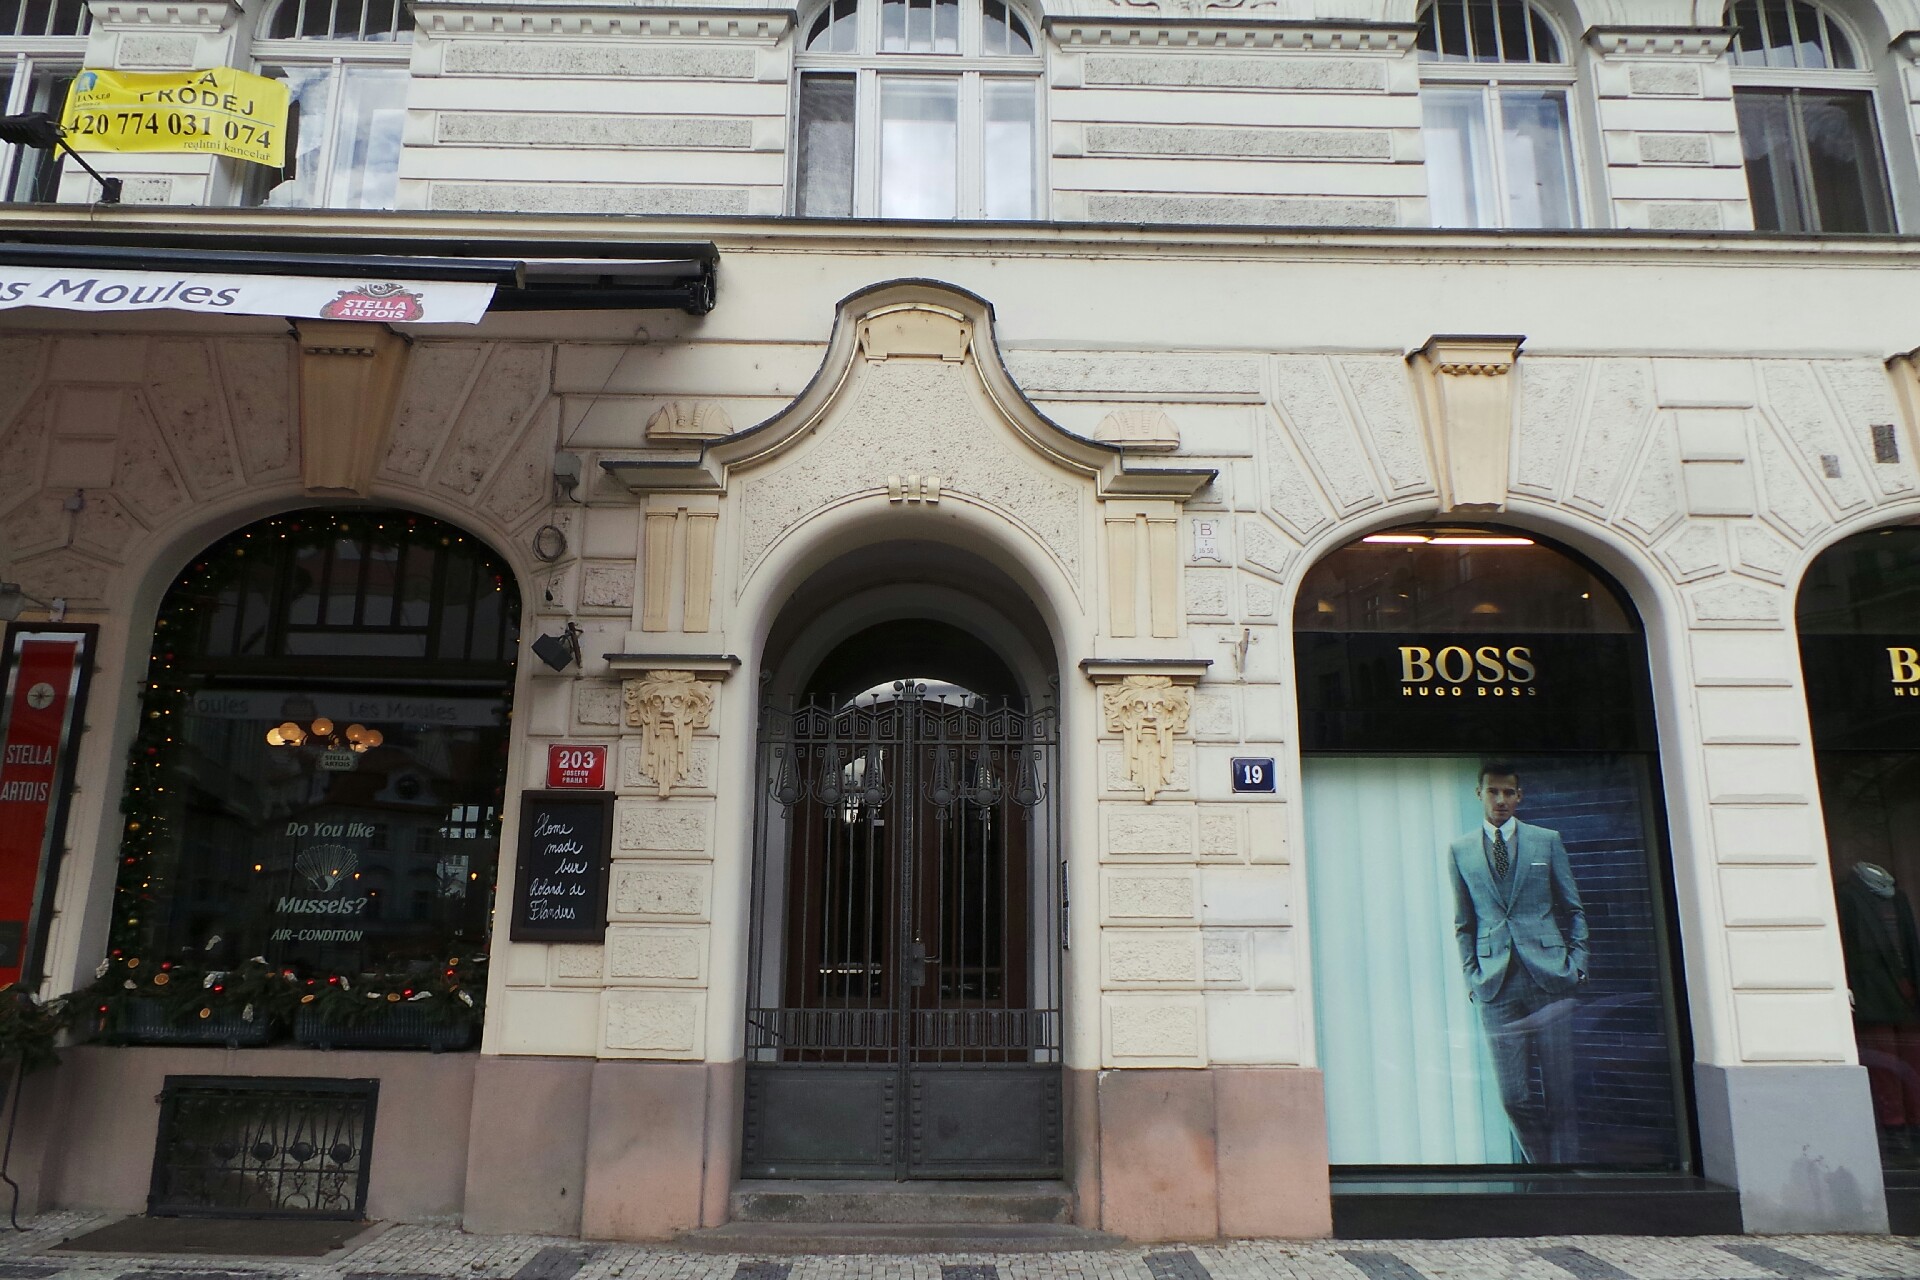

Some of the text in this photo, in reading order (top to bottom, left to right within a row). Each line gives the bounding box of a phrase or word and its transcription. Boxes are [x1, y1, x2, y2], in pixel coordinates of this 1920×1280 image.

[117, 113, 159, 135] 774
[168, 113, 212, 136] 031
[224, 120, 271, 149] 074
[37, 278, 241, 306] Moules
[338, 309, 406, 319] ARTOIS
[344, 300, 407, 310] STELLA
[1201, 523, 1212, 536] B
[1398, 646, 1536, 683] BOSS
[1886, 647, 1920, 683] B
[1402, 687, 1536, 696] HUGO BOSS
[1894, 687, 1920, 696] HU
[7, 744, 52, 765] STELLA
[558, 750, 595, 769] 203
[561, 776, 583, 784] PRAHA
[562, 769, 589, 777] JOSEFOV
[1244, 765, 1263, 784] 19
[1, 781, 48, 801] ARTOIS
[286, 822, 376, 838] Do You like
[534, 812, 574, 838] Home
[544, 838, 583, 856] made
[529, 877, 586, 896] Roland de
[276, 896, 368, 914] Mussels?
[271, 929, 364, 941] AIR-CONDITION
